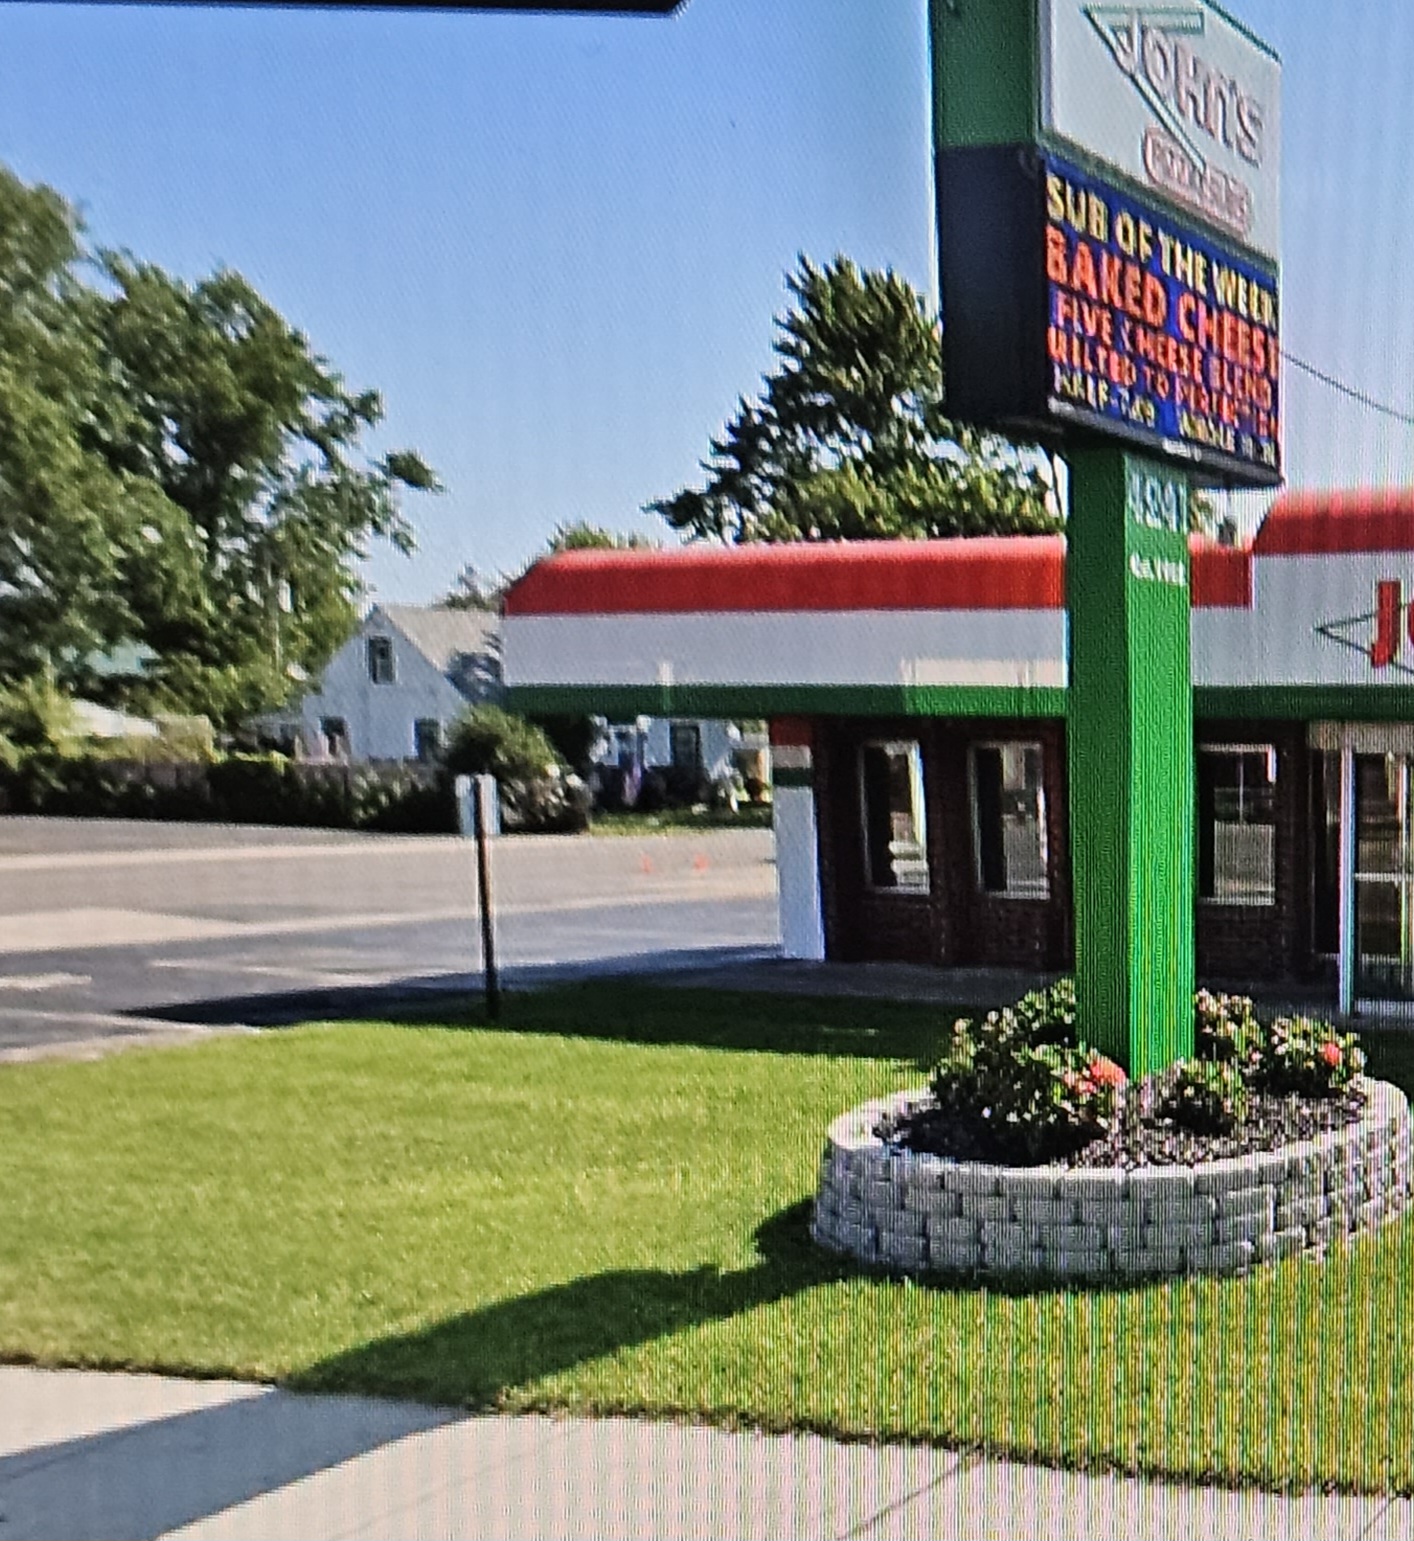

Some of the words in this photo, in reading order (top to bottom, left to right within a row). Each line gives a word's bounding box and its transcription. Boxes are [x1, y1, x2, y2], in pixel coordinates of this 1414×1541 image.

[1046, 224, 1167, 328] BAKED
[1047, 171, 1108, 242] SUB
[1115, 209, 1152, 263] OF
[1158, 228, 1207, 298] THE
[1057, 290, 1112, 345] FIVE
